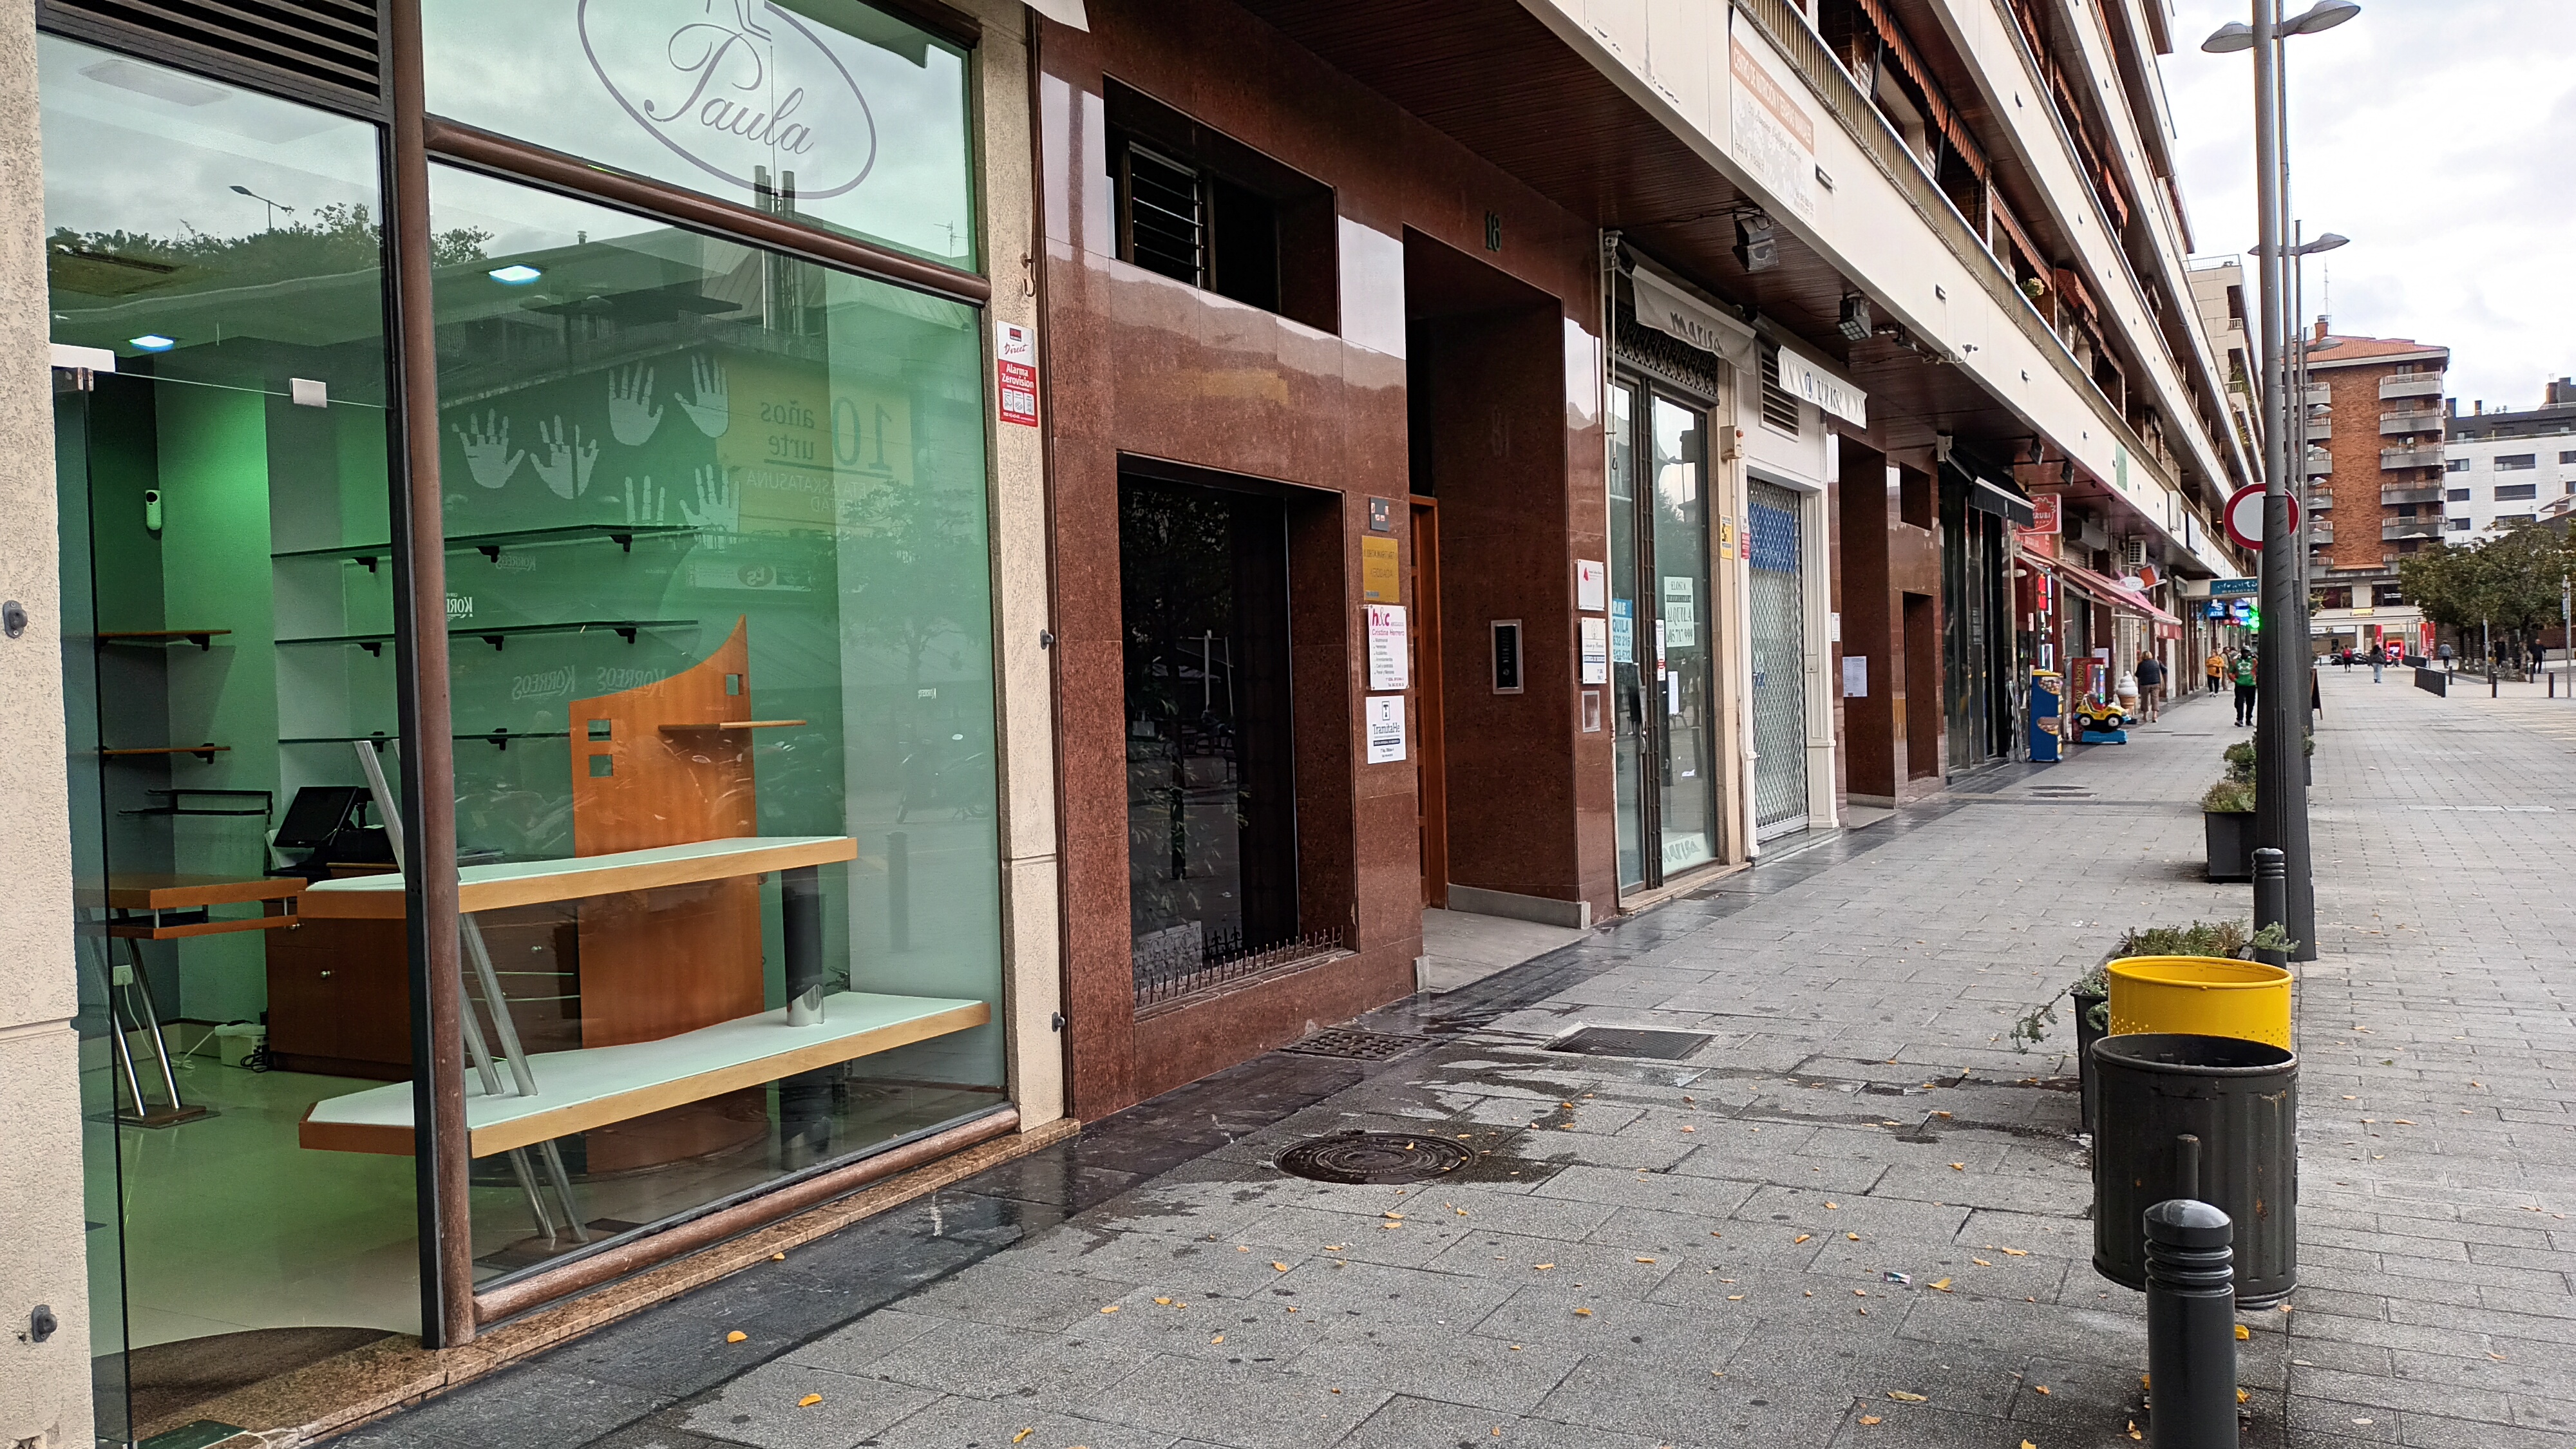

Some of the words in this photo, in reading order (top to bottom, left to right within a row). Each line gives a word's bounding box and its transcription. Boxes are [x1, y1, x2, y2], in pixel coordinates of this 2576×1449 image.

[644, 23, 814, 155] Paula
[1485, 211, 1502, 252] 18
[1669, 312, 1725, 355] marisa
[1006, 363, 1029, 377] Alarma
[1001, 372, 1034, 388] Zerovision
[1667, 607, 1692, 626] ALQUILA
[1372, 722, 1401, 735] TramitaHe
